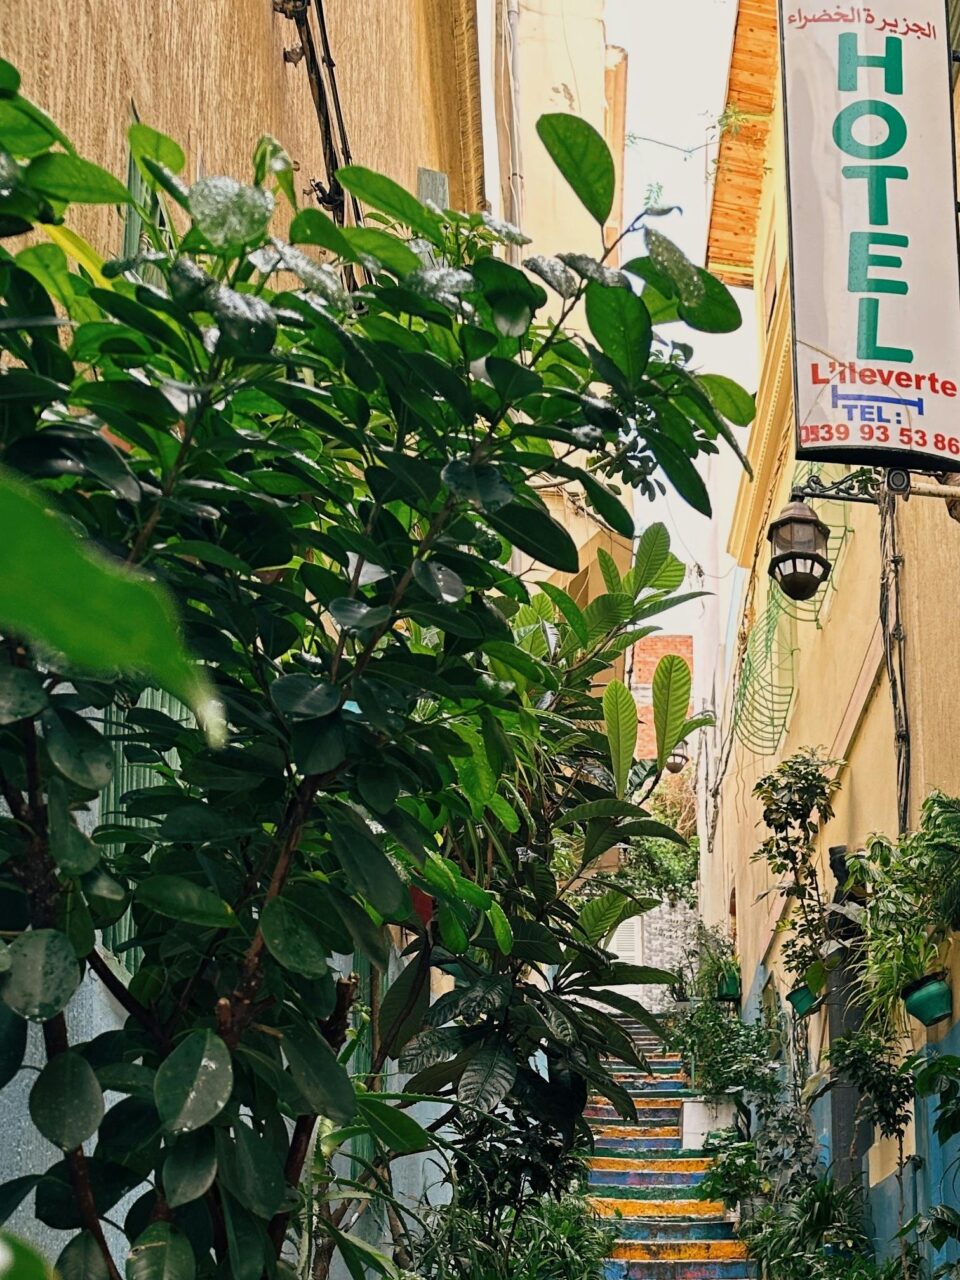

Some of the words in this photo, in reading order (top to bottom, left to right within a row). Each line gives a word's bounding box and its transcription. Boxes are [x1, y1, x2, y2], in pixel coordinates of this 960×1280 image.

[787, 5, 861, 30] الخضراء
[861, 8, 937, 40] الجزيرة
[832, 32, 913, 363] HOTEL
[859, 424, 890, 443] 93
[899, 427, 928, 448] 53
[933, 433, 960, 455] 86
